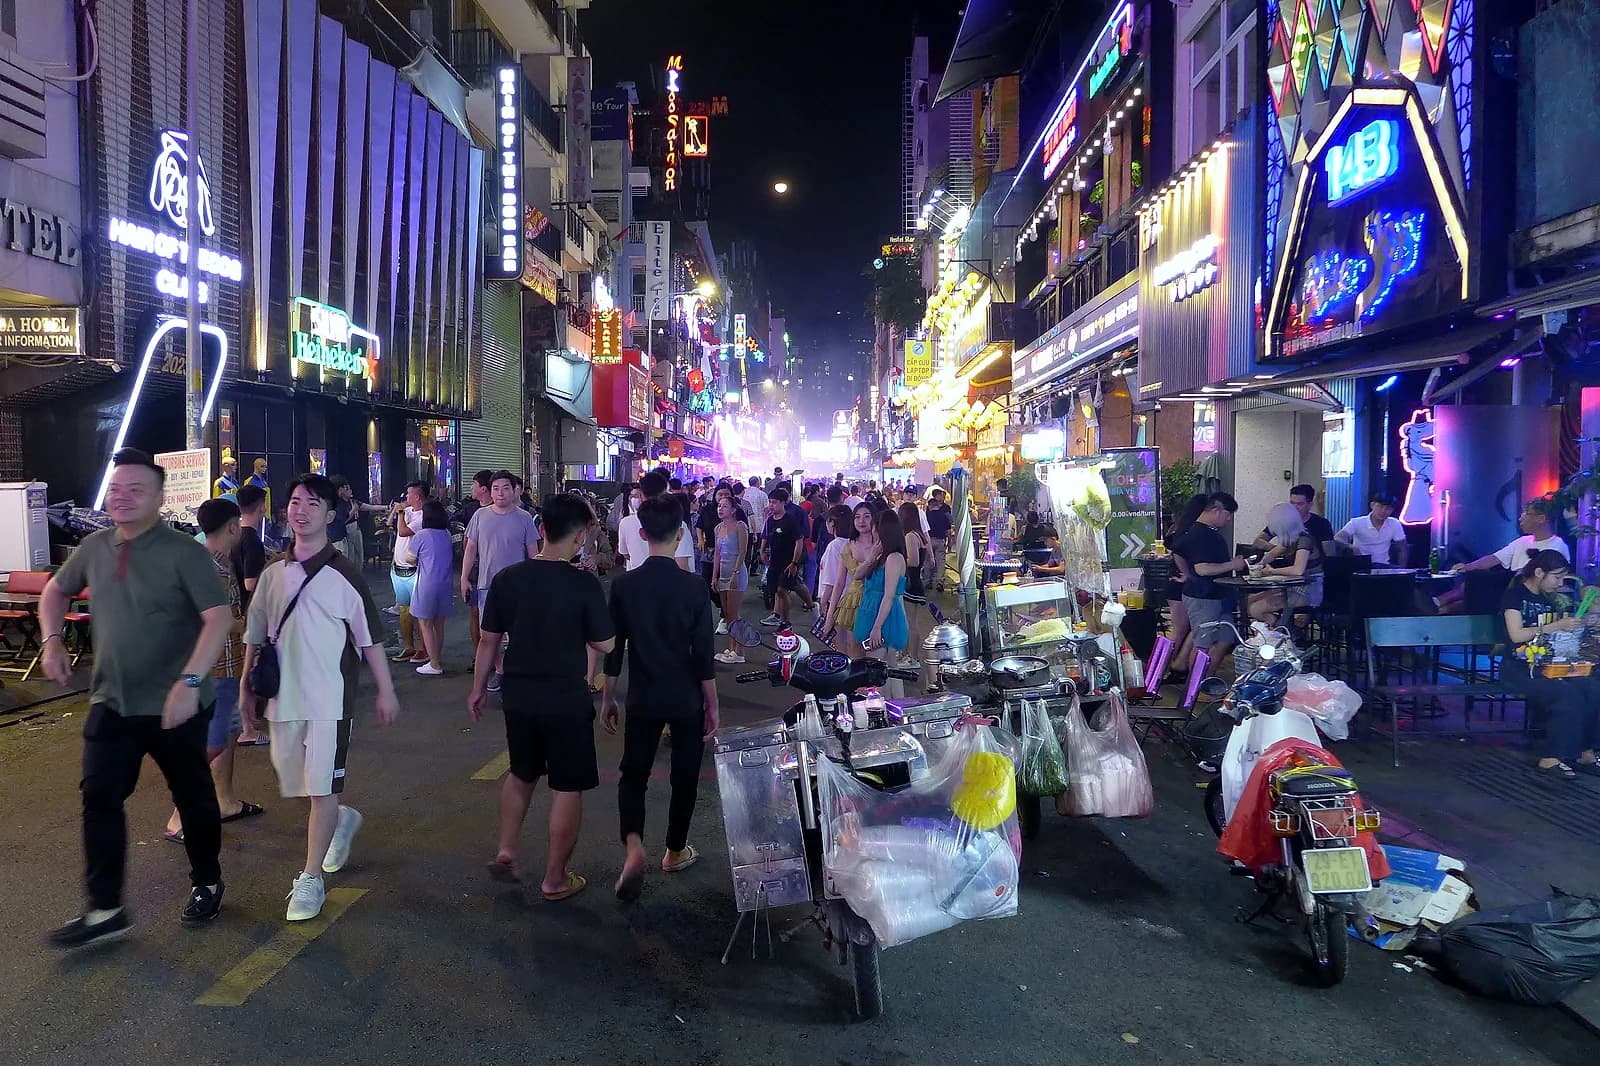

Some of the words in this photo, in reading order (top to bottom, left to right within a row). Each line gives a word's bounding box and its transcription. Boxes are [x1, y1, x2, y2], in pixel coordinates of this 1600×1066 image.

[0, 198, 80, 267] TEL
[652, 223, 664, 277] Elite
[5, 335, 73, 347] INFORMATION
[20, 317, 70, 333] HOTEL
[161, 351, 187, 376] 202
[295, 331, 362, 375] Heineken
